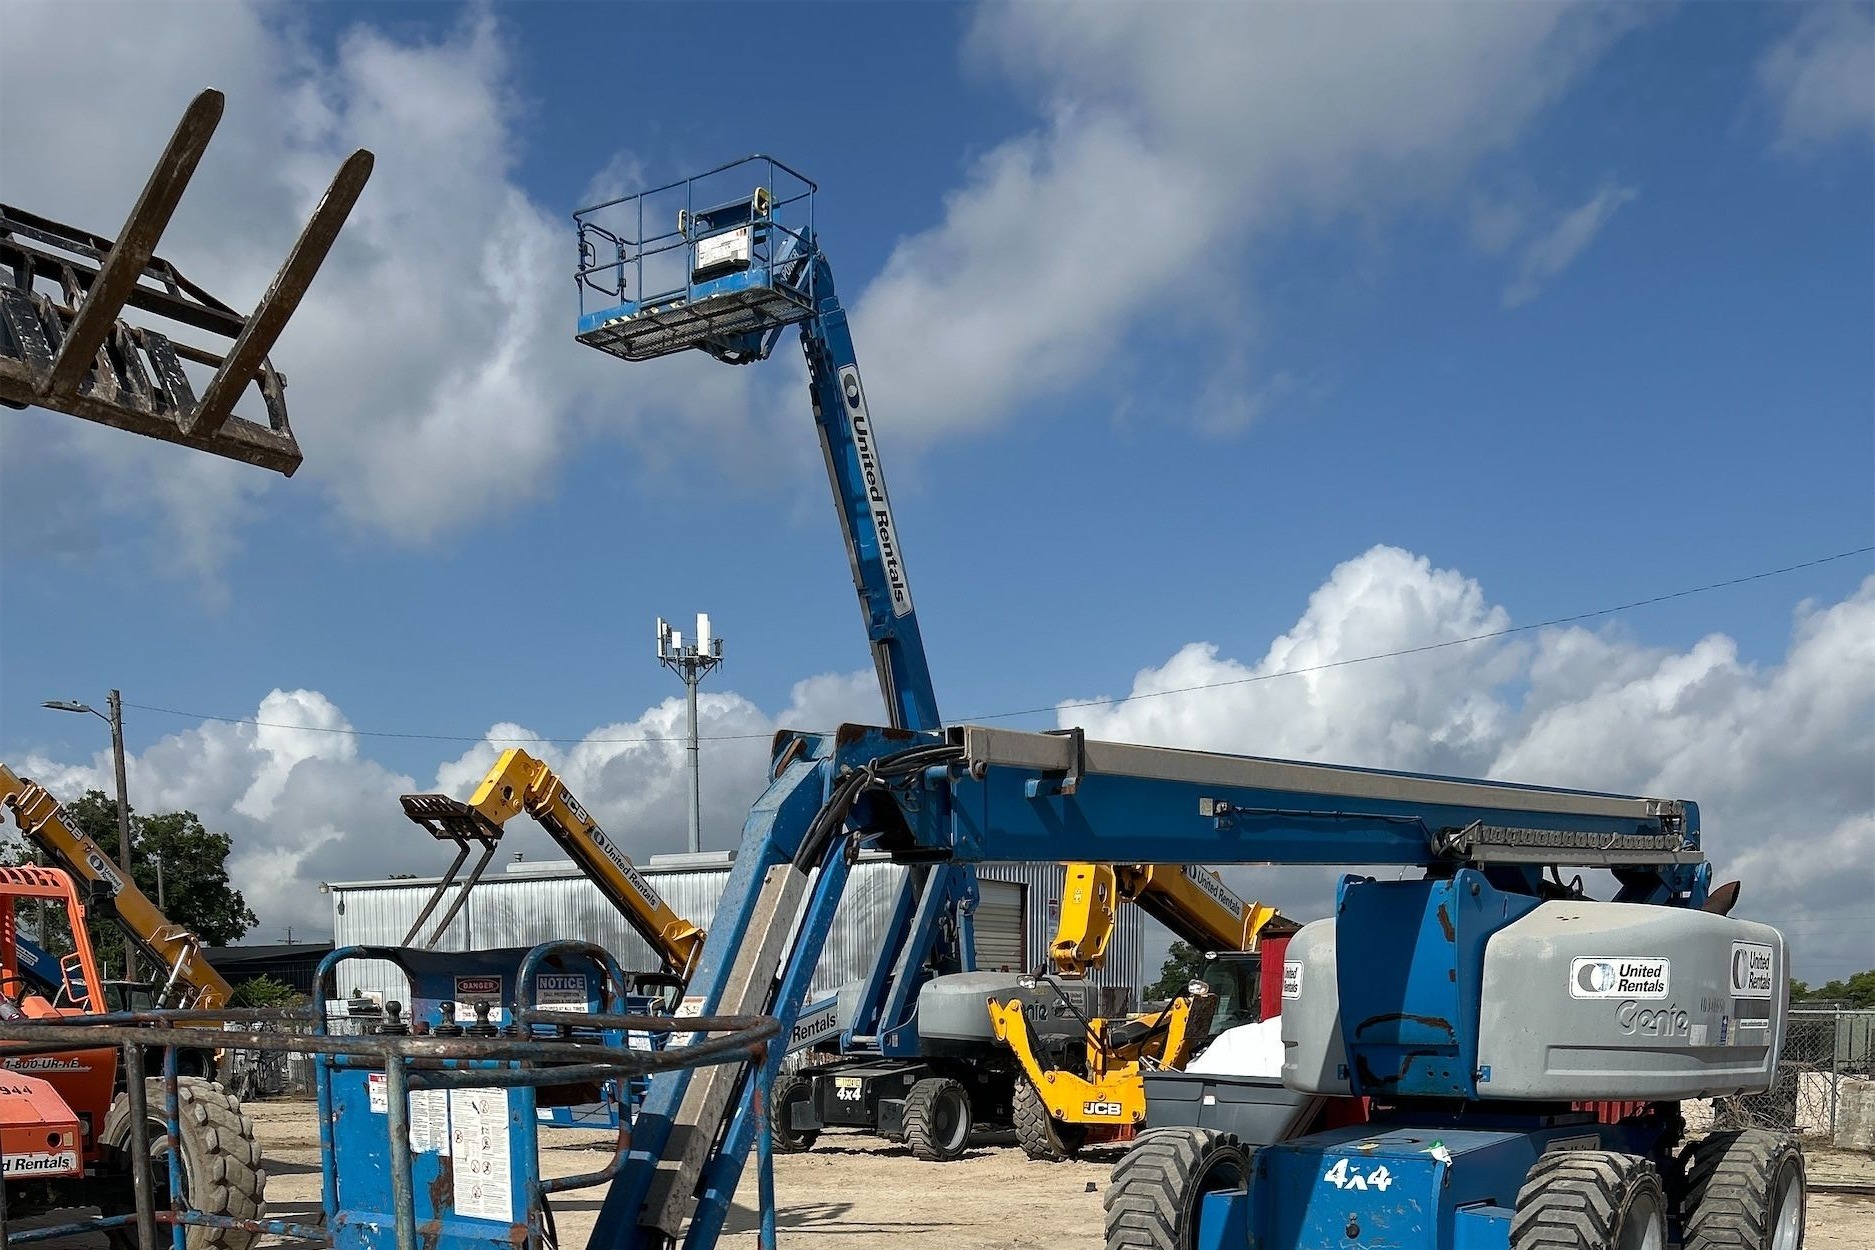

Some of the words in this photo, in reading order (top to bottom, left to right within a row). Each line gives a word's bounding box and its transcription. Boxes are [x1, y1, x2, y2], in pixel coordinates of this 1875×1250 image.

[853, 416, 884, 503] United
[875, 510, 905, 603] Rentals
[559, 789, 588, 824] JCB
[56, 810, 84, 841] JCB
[604, 843, 632, 876] United
[629, 873, 657, 907] Rentals
[1197, 871, 1219, 898] United
[1218, 888, 1240, 916] Rentals
[1619, 963, 1663, 978] United
[1750, 951, 1770, 970] United
[540, 977, 584, 989] NOTICE
[1618, 979, 1665, 993] Rentals
[1749, 971, 1770, 990] Rentals
[1026, 1001, 1048, 1021] nie
[1615, 999, 1690, 1037] Genie
[793, 1012, 836, 1043] Rentals
[837, 1087, 862, 1101] 4x4
[1083, 1103, 1121, 1116] JCB
[15, 1156, 70, 1171] Rentals
[1323, 1158, 1393, 1192] 4x4
